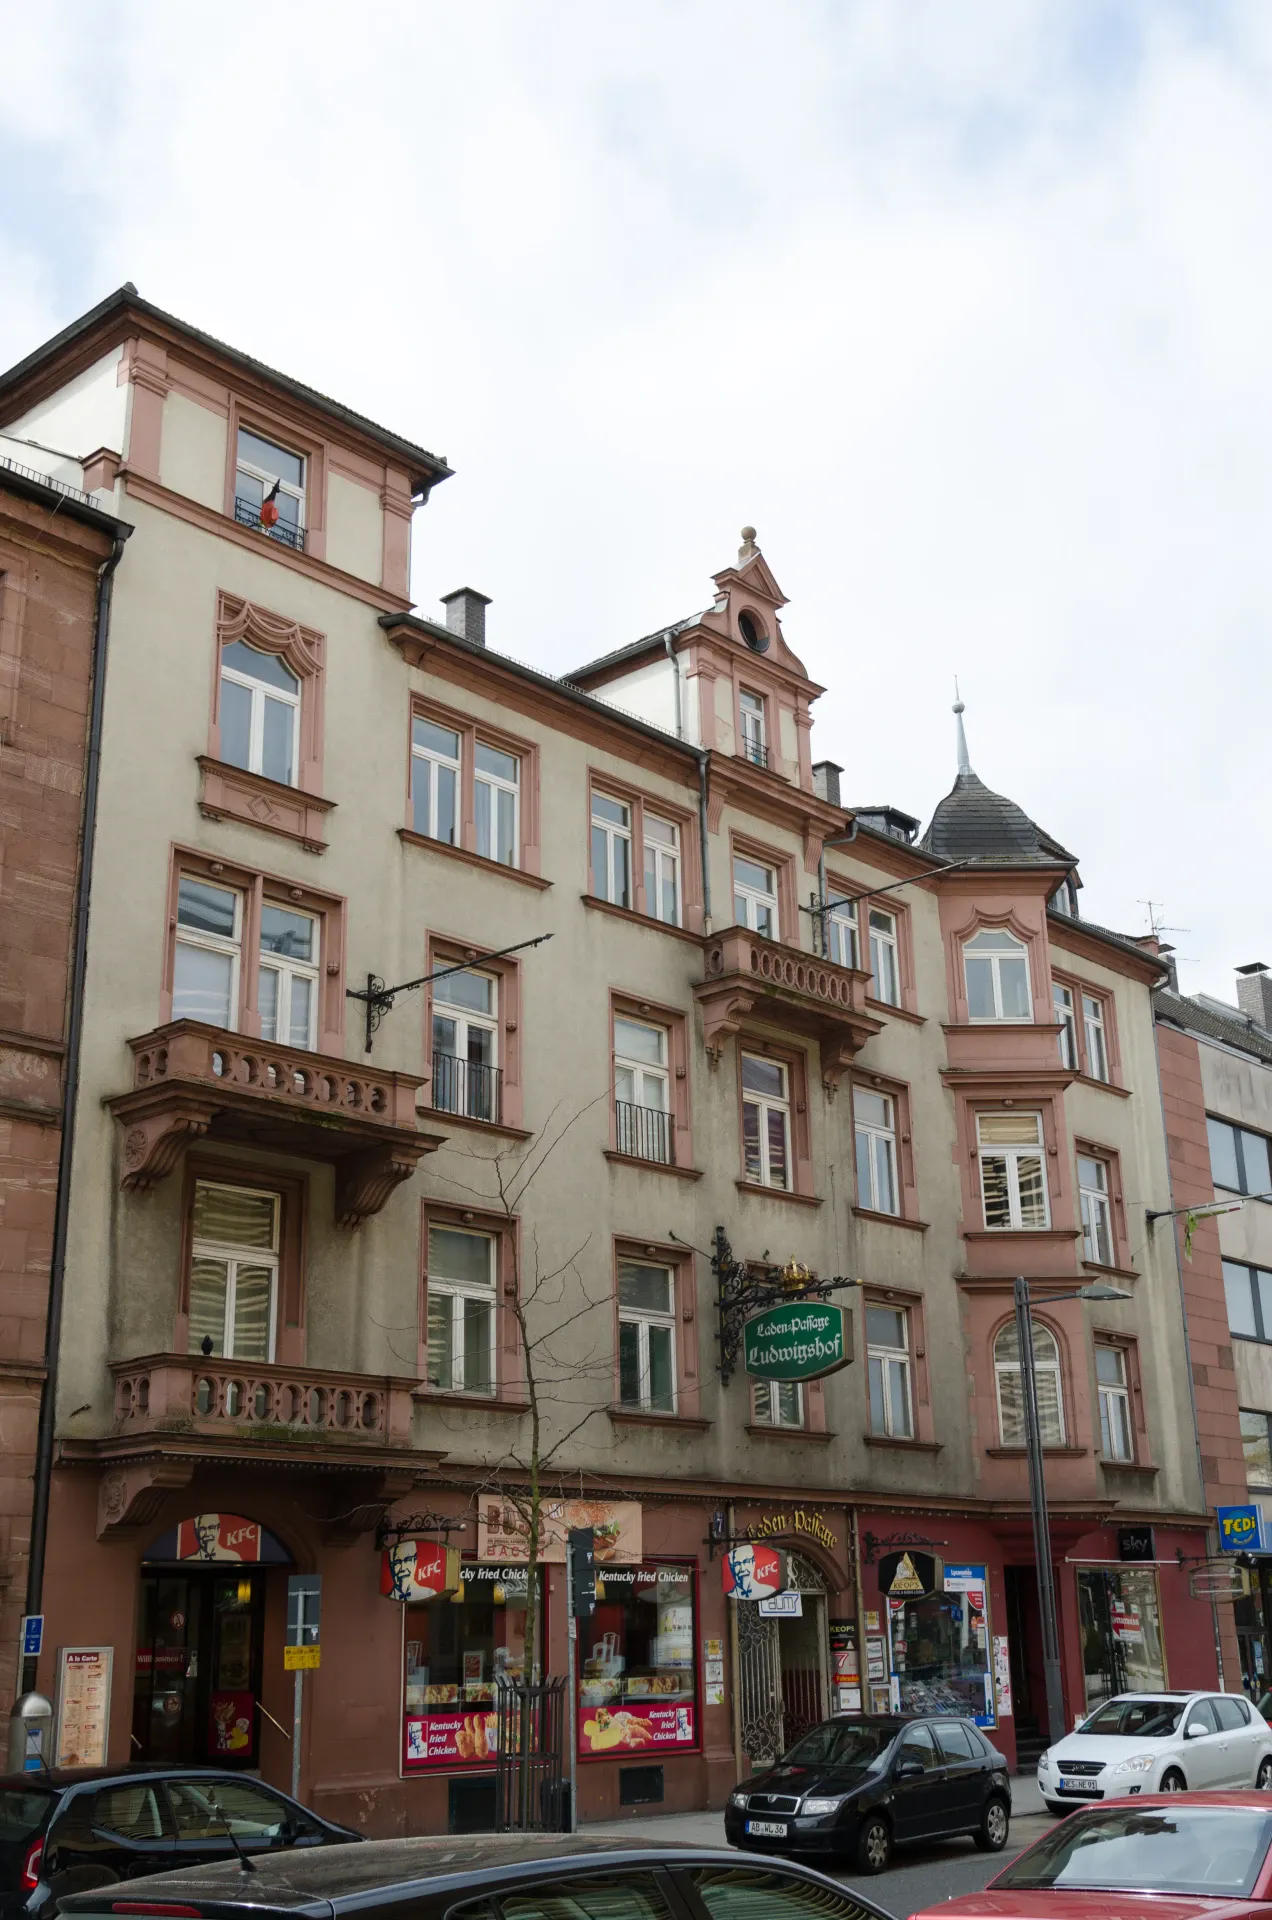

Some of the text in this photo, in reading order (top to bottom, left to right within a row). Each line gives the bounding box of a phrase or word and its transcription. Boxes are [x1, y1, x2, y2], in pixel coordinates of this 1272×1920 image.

[747, 1333, 841, 1365] Ludwigshof
[226, 1525, 256, 1546] KFC
[1122, 1535, 1148, 1553] sky
[417, 1560, 441, 1581] KFC
[477, 1568, 500, 1580] Fried
[501, 1567, 538, 1580] Chick
[756, 1562, 779, 1580] KFC
[599, 1570, 689, 1585] Kentucky Fried Chicken
[833, 1651, 849, 1668] 7
[649, 1709, 676, 1720] Kentucky
[428, 1720, 463, 1732] Kentucky
[661, 1721, 676, 1729] Fried
[429, 1733, 447, 1744] Fried
[653, 1732, 676, 1741] Chicken
[428, 1746, 457, 1756] Chicken
[1063, 1780, 1096, 1790] NES NE 91
[751, 1822, 760, 1832] AB
[774, 1824, 784, 1834] 36
